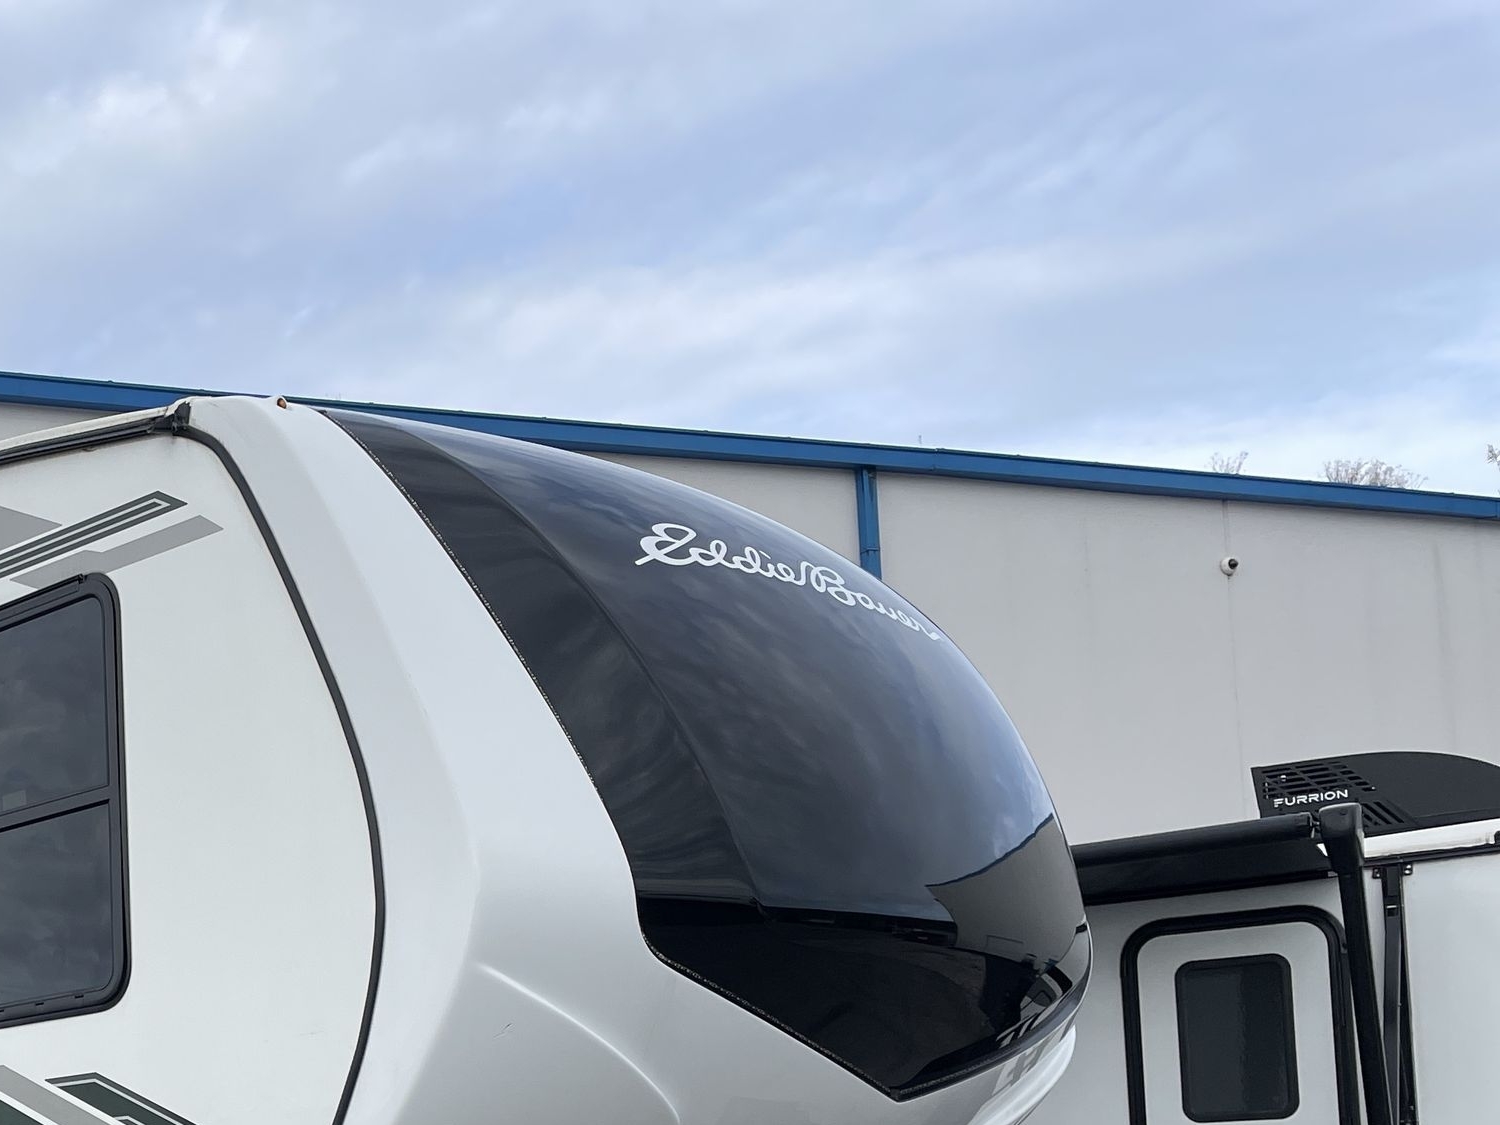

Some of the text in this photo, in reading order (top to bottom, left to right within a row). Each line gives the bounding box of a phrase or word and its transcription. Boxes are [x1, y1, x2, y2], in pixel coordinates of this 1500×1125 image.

[634, 522, 941, 641] Eddie Bauer
[1273, 789, 1349, 808] FURRION
